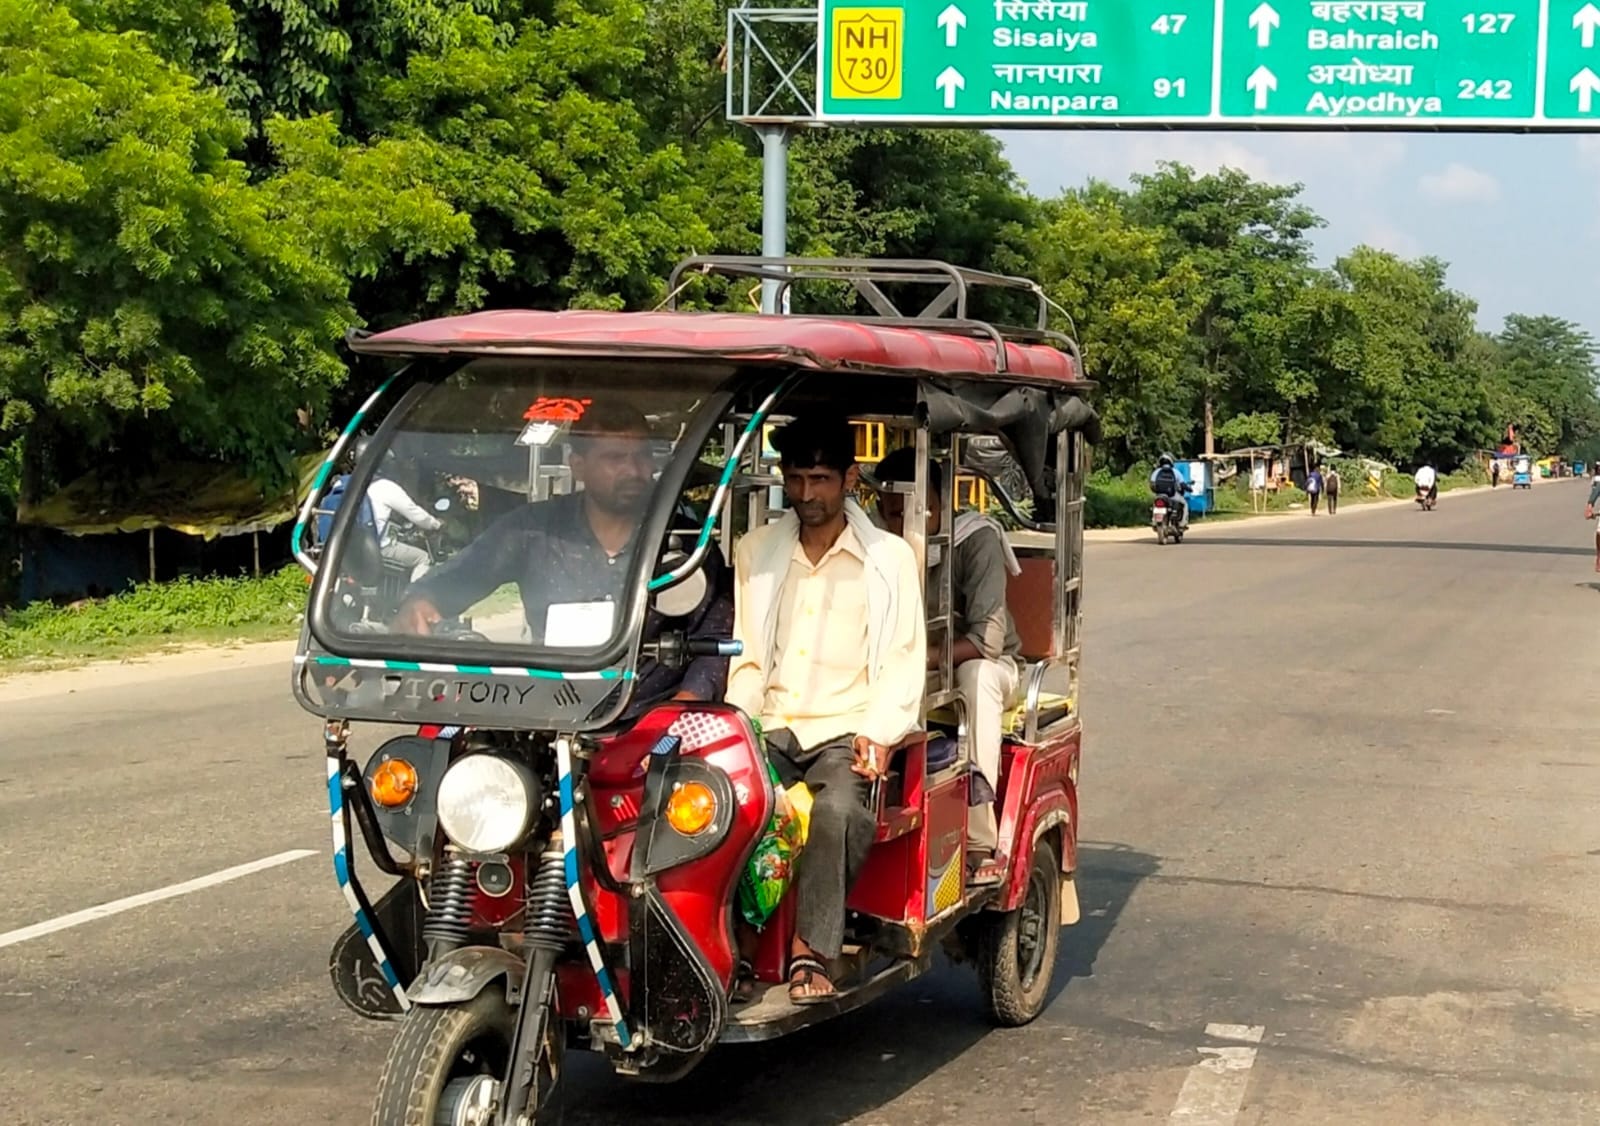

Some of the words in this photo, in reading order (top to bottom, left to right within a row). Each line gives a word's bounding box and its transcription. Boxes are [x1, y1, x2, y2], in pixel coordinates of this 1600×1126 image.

[1310, 1, 1426, 25] बहराइच
[1462, 13, 1515, 33] 127
[1151, 15, 1187, 34] 47
[846, 27, 888, 48] NH
[994, 28, 1097, 51] Sisaiya
[1307, 29, 1438, 50] Bahraich
[845, 57, 887, 79] 730
[993, 64, 1102, 83] नानपारा
[1308, 57, 1413, 85] अयोध्या
[1153, 78, 1185, 98] 91
[1457, 79, 1512, 99] 242
[991, 91, 1119, 115] Nanpara
[1306, 92, 1442, 117] Ayodhya
